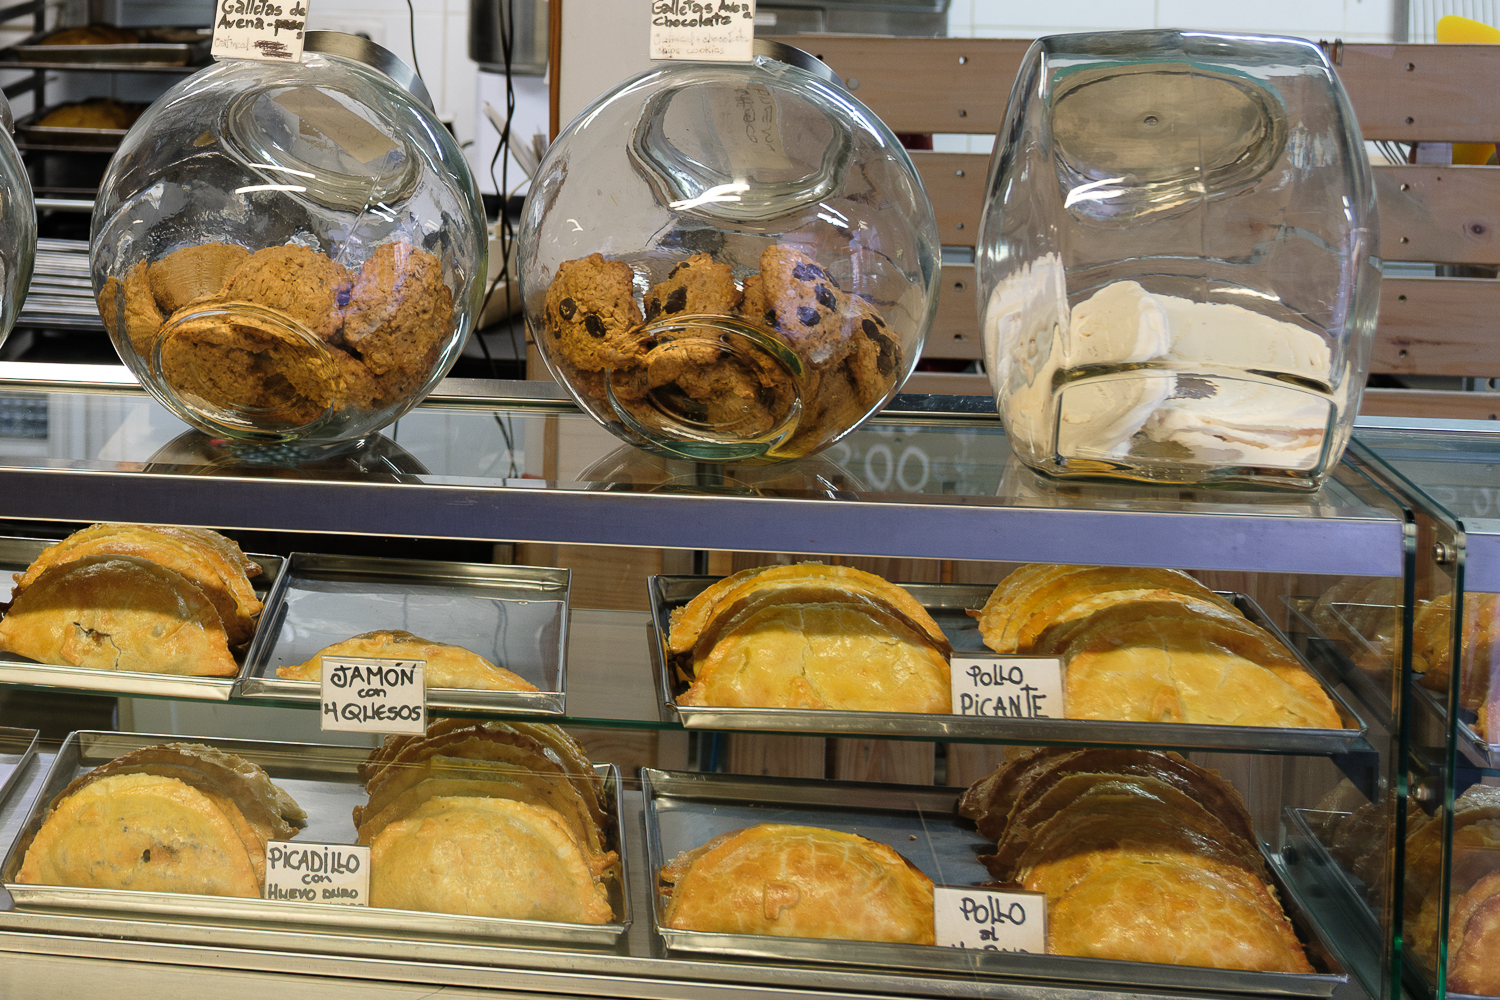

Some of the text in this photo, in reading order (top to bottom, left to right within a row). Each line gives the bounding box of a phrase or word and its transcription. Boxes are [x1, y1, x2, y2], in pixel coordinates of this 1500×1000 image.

[289, 1, 306, 17] de
[330, 662, 417, 689] JAMÓN
[965, 664, 1024, 687] POLLO
[357, 688, 387, 699] con
[341, 702, 422, 723] QUESOS
[301, 874, 333, 885] con
[267, 883, 317, 901] HUEVO
[959, 895, 1026, 926] POLLO
